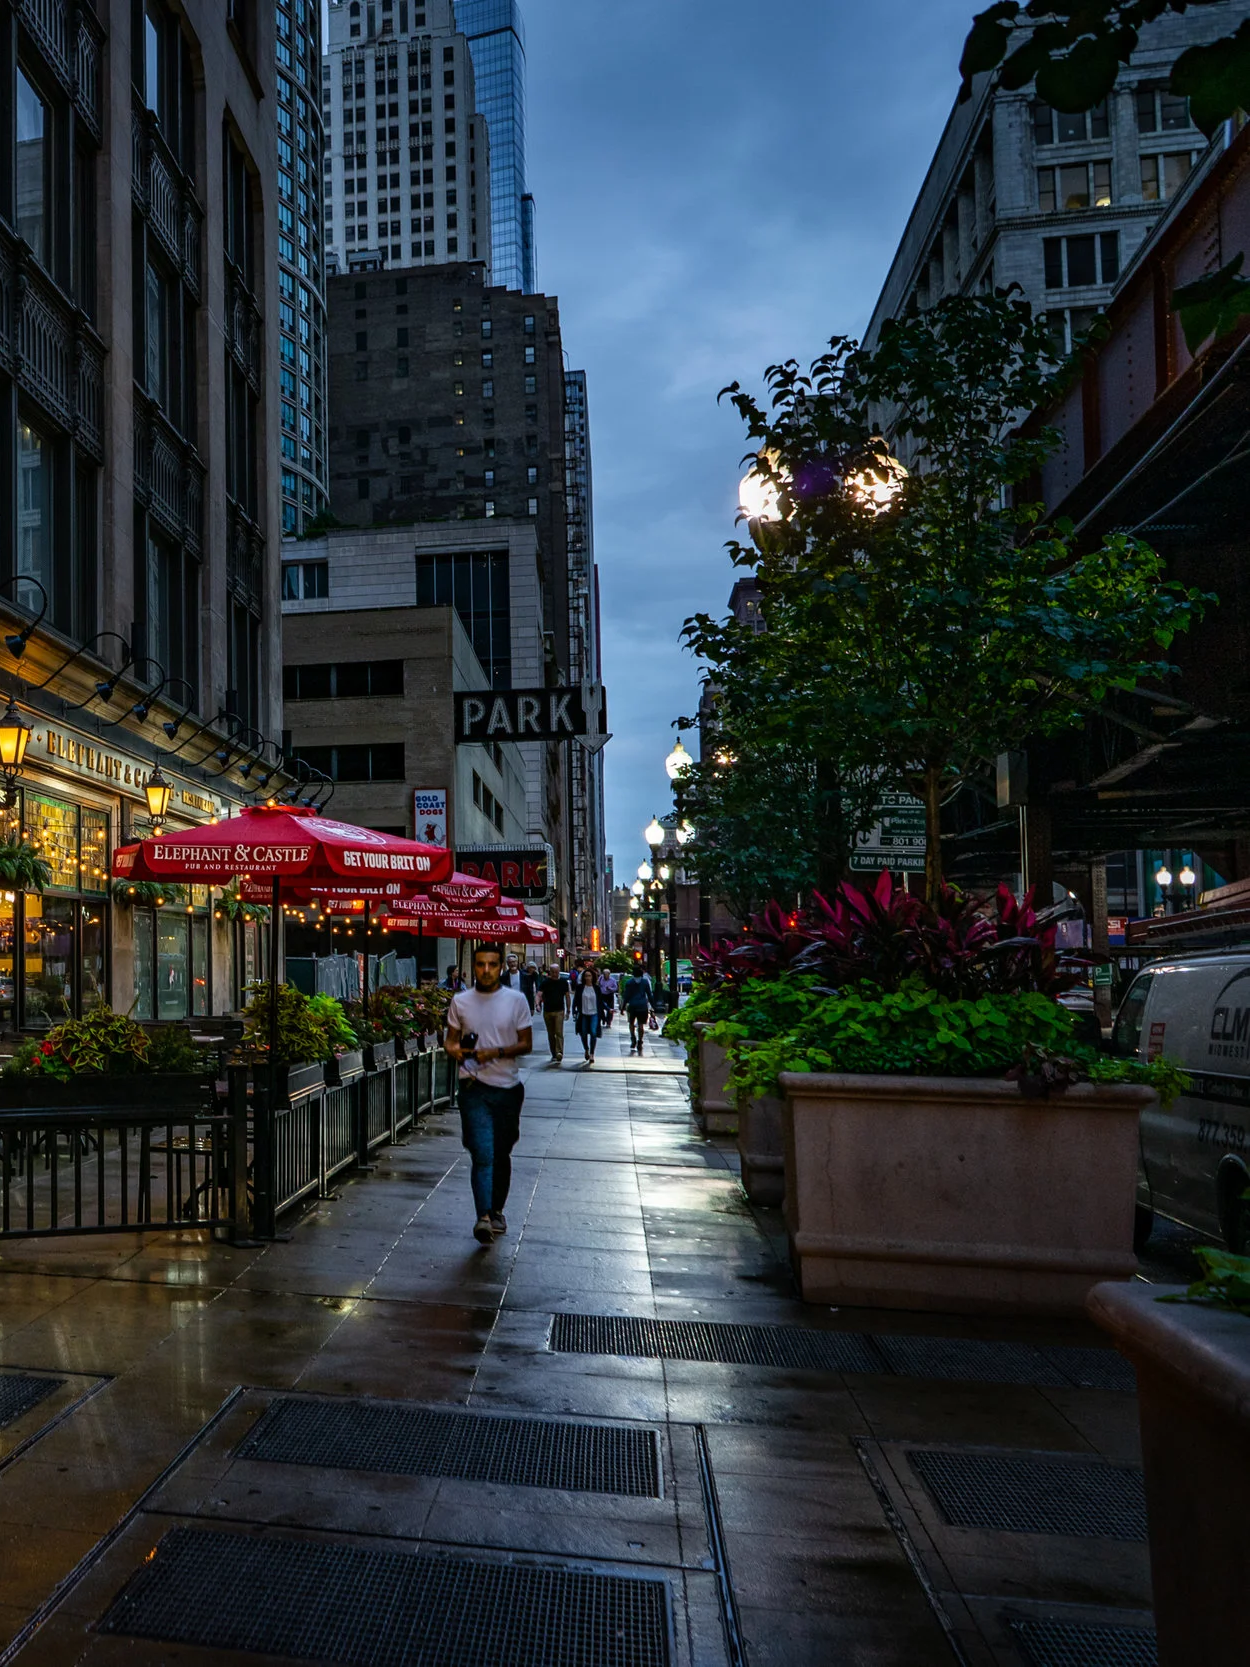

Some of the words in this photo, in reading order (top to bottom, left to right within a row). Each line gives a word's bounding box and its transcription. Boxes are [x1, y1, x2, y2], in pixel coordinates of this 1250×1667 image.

[462, 694, 574, 736] PARK
[47, 730, 123, 781] ELEPHANT
[124, 765, 132, 784] &
[912, 838, 926, 846] 90
[154, 844, 231, 861] ELEPHANT
[234, 844, 250, 862] &
[253, 846, 309, 862] CASTLE
[343, 850, 361, 867] GET
[362, 852, 389, 869] YOUR
[390, 854, 414, 870] BRIT
[416, 856, 430, 871] ON
[860, 857, 876, 865] DAY
[877, 858, 896, 866] PAID
[897, 858, 925, 867] PARKIN
[462, 861, 543, 888] PARK
[386, 883, 401, 894] ON
[392, 900, 439, 911] ELEPHANT
[444, 919, 482, 931] ELEPHANT
[483, 920, 492, 931] &
[492, 922, 521, 933] CASTLE
